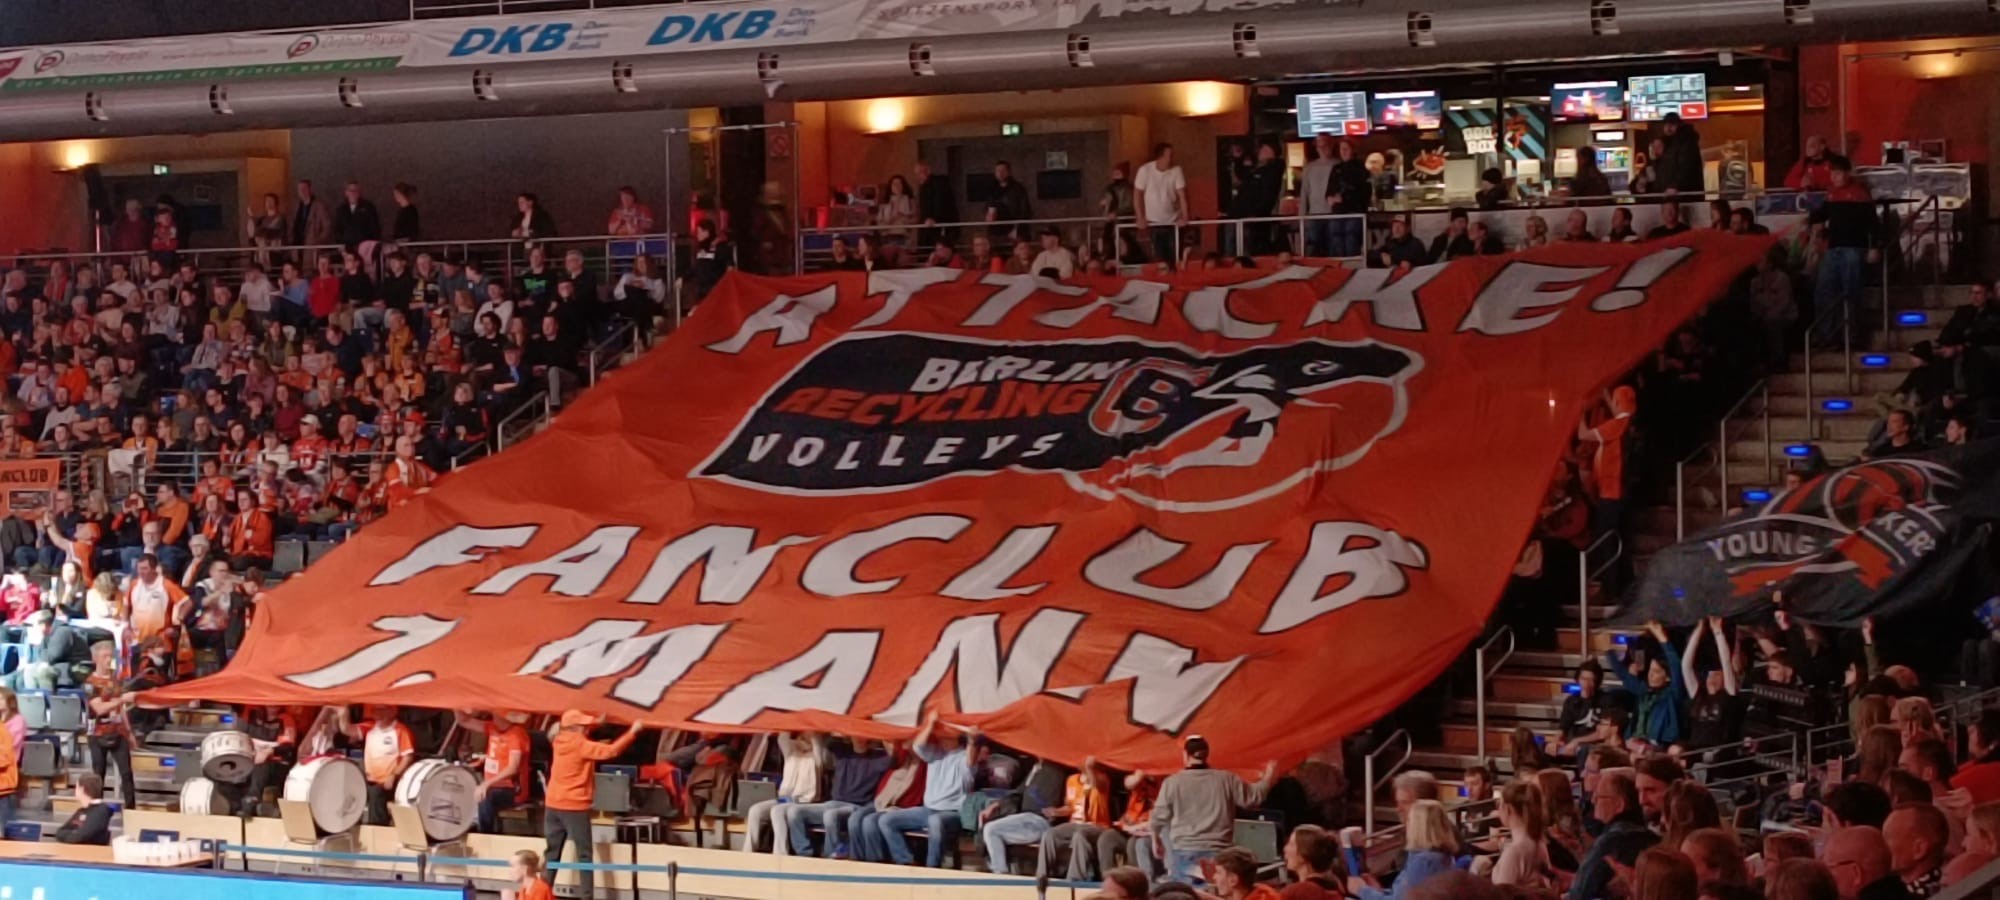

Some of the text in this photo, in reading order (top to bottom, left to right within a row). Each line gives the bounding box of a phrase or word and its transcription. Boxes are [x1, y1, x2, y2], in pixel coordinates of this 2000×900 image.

[447, 22, 573, 57] DKB
[646, 9, 777, 46] DKB
[703, 246, 1698, 355] ATTACKE!
[773, 379, 1101, 426] RECYCLING
[746, 431, 1063, 472] VOLLEYS
[1706, 530, 1817, 562] YOUNG
[366, 513, 1430, 635] FANCLUB
[505, 606, 1252, 738] MANN
